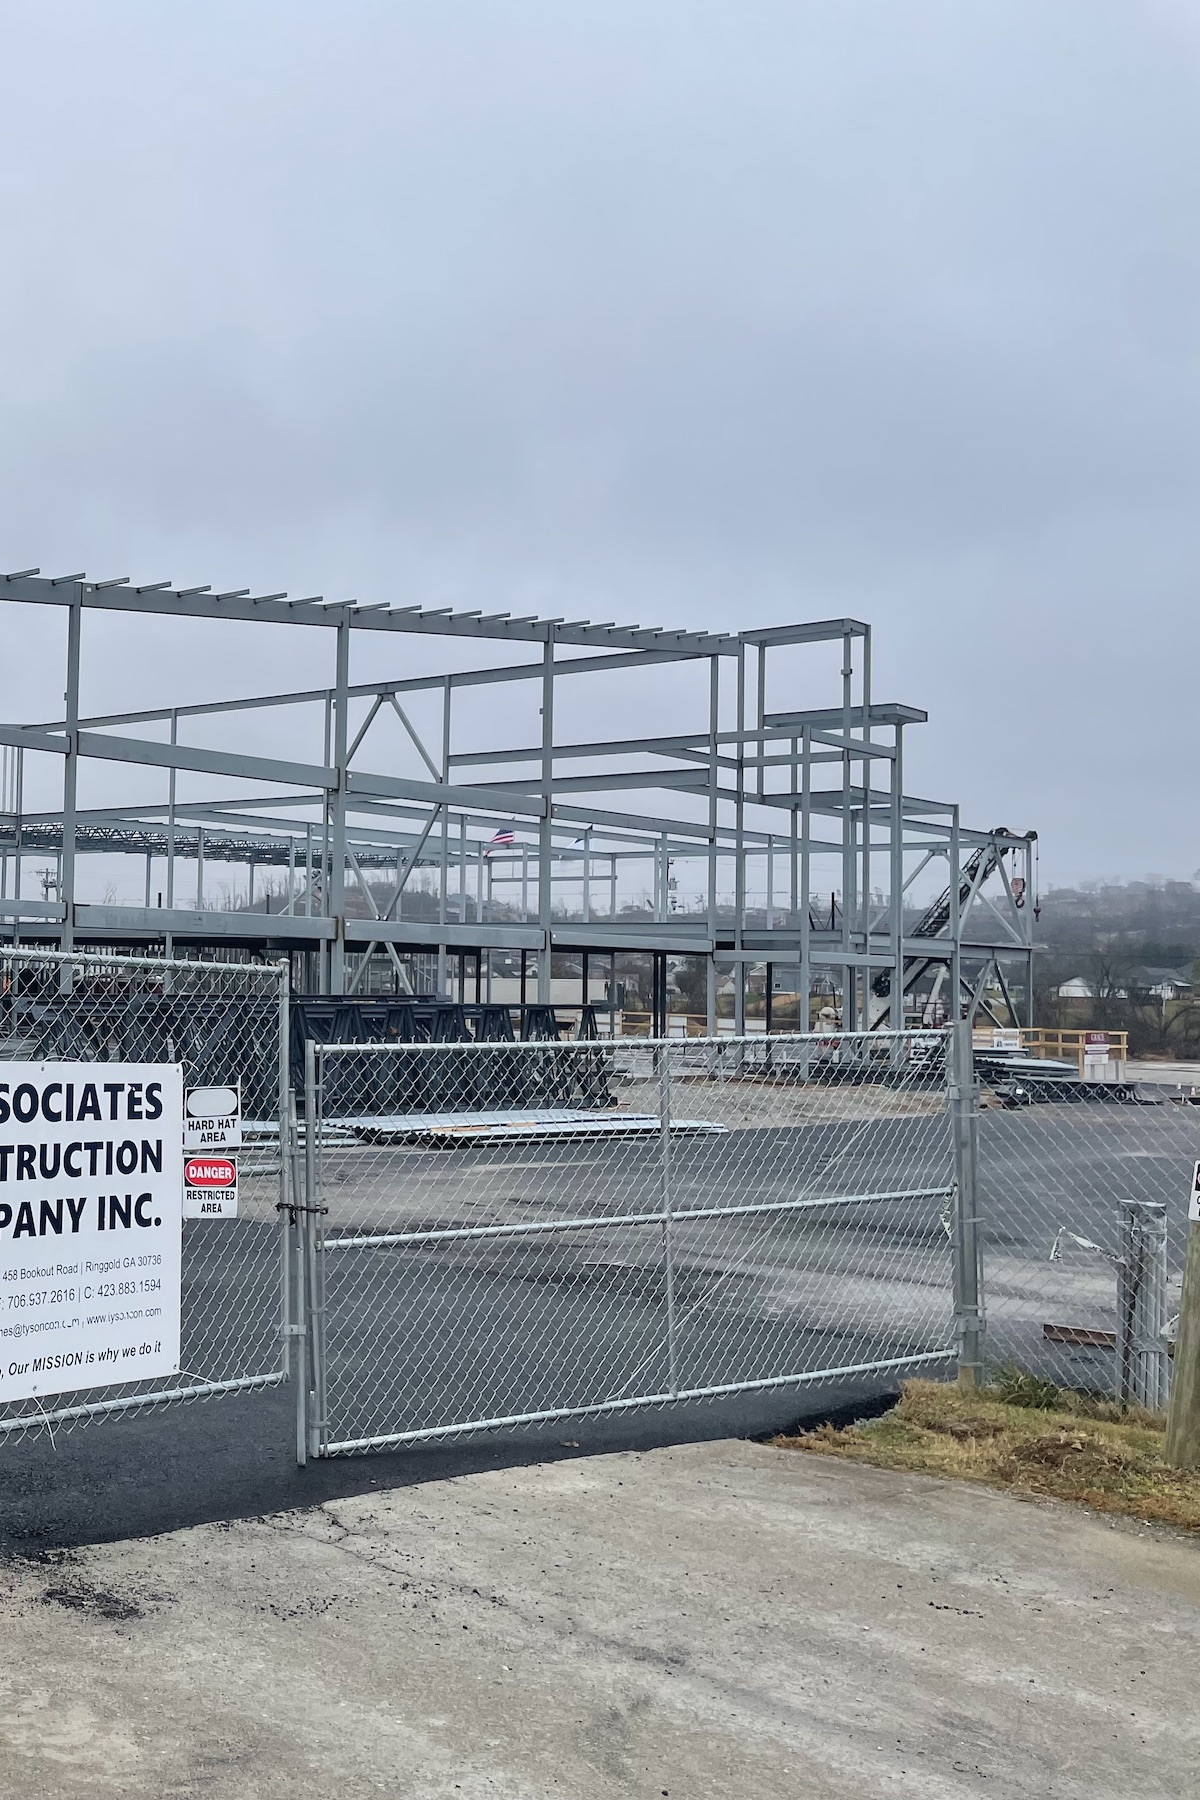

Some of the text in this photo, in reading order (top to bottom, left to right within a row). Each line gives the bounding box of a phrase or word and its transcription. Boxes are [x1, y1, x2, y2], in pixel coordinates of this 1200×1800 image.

[188, 1119, 236, 1131] HARD HAT
[200, 1132, 226, 1143] AREA
[189, 1165, 232, 1179] DANGER
[186, 1190, 235, 1200] RESTRICTED
[97, 1193, 162, 1231] INC.
[200, 1203, 222, 1213] AREA
[2, 1269, 18, 1282] 458
[20, 1266, 54, 1280] Bookout
[56, 1262, 78, 1276] Road
[85, 1258, 120, 1273] Ringgold
[123, 1257, 136, 1267] GA
[137, 1254, 162, 1267] 30736
[8, 1288, 75, 1309] 706.937.2616
[84, 1286, 95, 1299] C:
[97, 1278, 161, 1298] 423.883.1594
[8, 1362, 30, 1376] Our
[32, 1351, 83, 1372] MISSION
[85, 1350, 95, 1363] is
[98, 1347, 119, 1363] why
[122, 1346, 136, 1358] we
[139, 1342, 152, 1355] do
[154, 1340, 162, 1353] it
